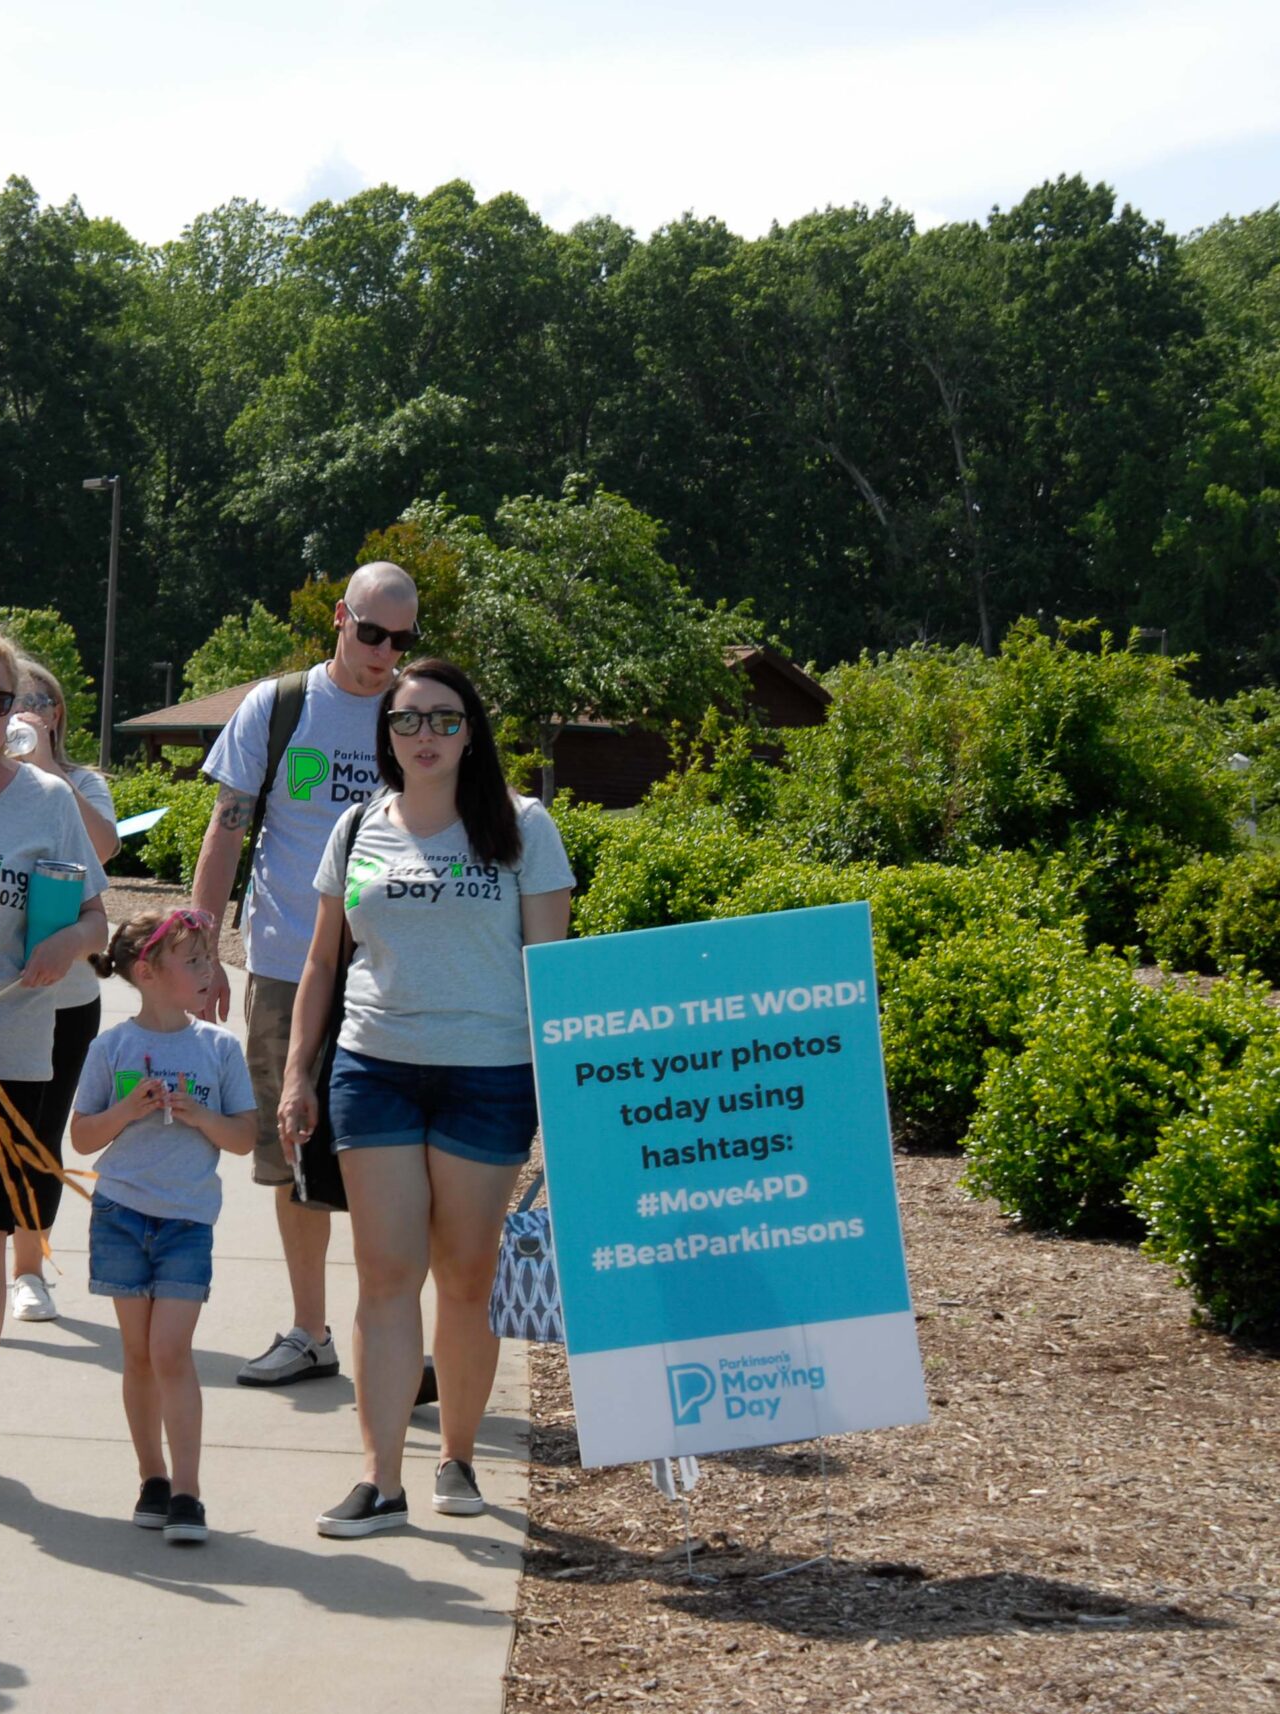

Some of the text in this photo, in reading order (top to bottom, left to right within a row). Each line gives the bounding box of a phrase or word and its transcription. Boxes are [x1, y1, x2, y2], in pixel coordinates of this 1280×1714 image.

[386, 879, 501, 903] Day 2022
[387, 863, 499, 884] ving
[542, 980, 867, 1044] SPREAD THE WORD!
[575, 1034, 842, 1086] Post your photos
[620, 1084, 805, 1127] today using
[641, 1132, 794, 1169] hashtags:
[636, 1174, 808, 1217] #Move4PD
[591, 1217, 864, 1271] #BeatParkinsons
[718, 1351, 791, 1371] Parkinson's
[724, 1396, 781, 1421] Day
